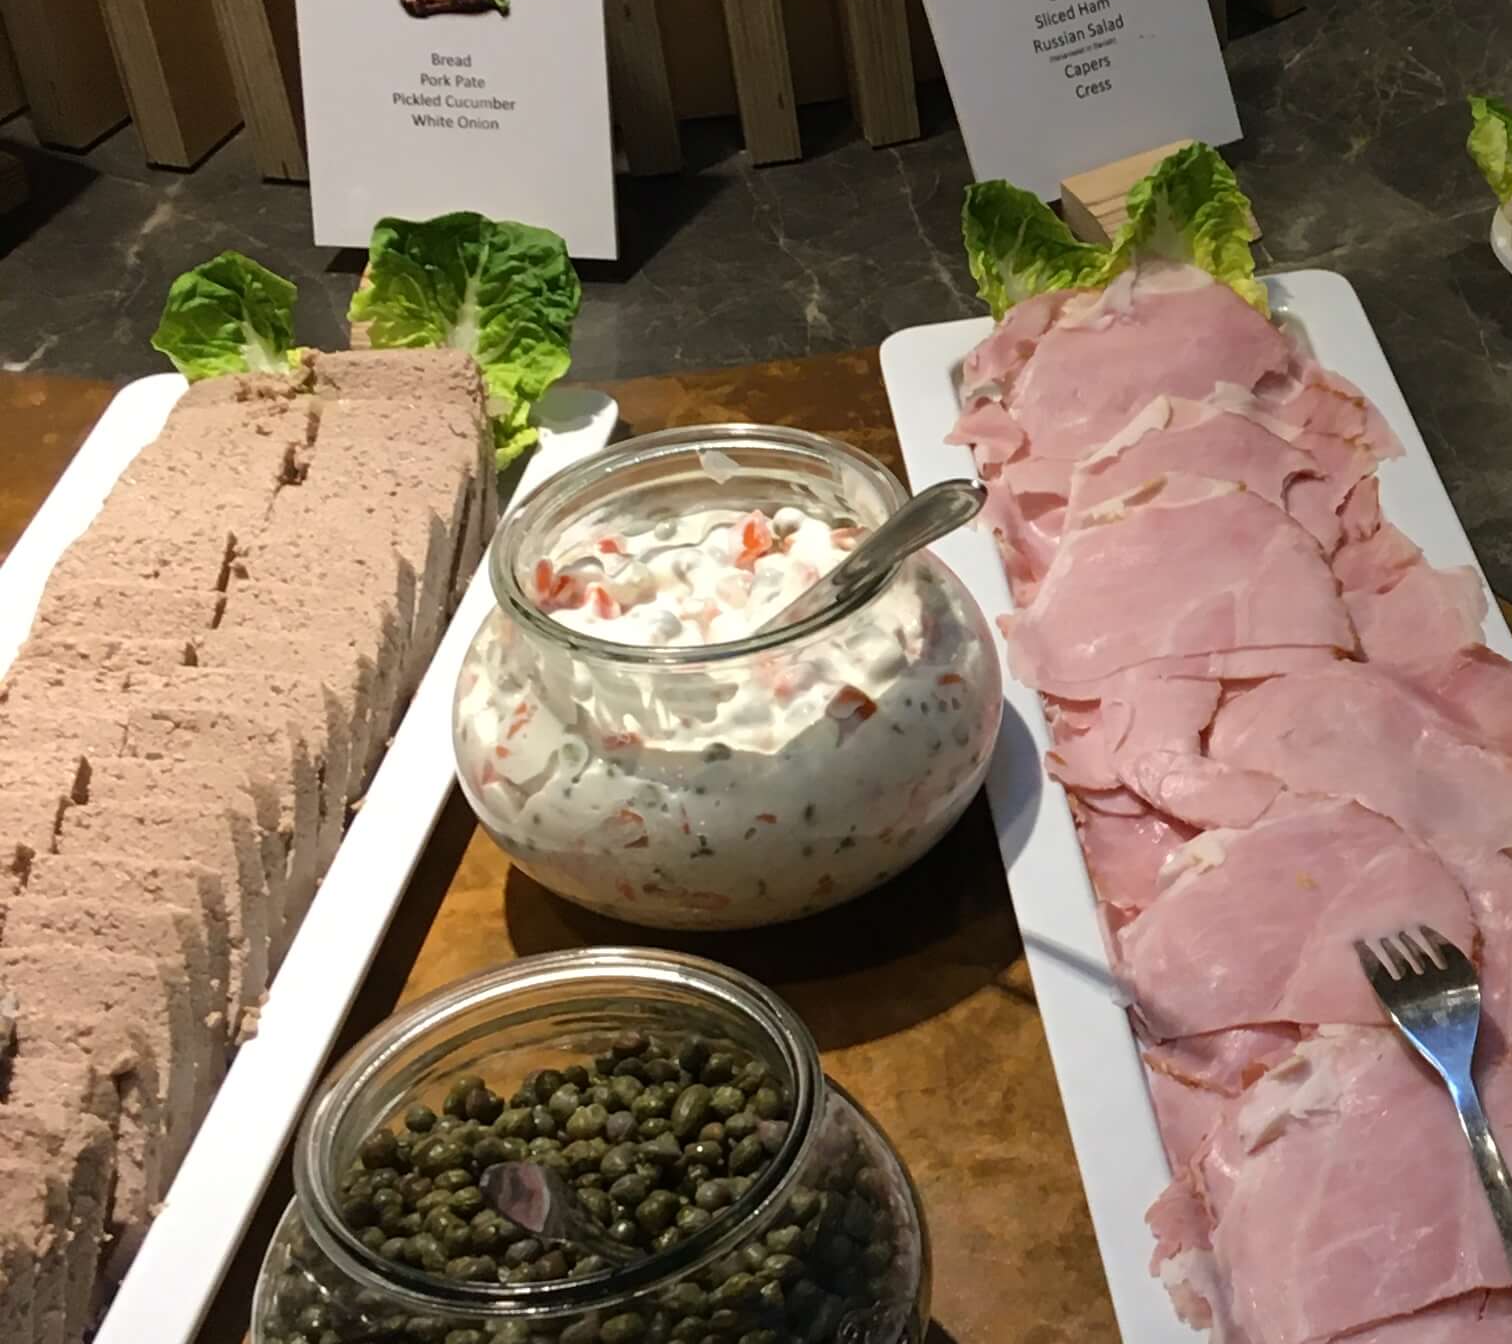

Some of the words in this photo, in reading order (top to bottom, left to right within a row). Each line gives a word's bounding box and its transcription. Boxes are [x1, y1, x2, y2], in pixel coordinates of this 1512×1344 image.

[1034, 4, 1076, 30] Sliced
[1033, 30, 1086, 54] Russian
[1087, 12, 1125, 38] Salad
[431, 52, 473, 68] Bread
[1064, 55, 1112, 79] Capers
[420, 72, 452, 88] Pork
[455, 74, 486, 89] Pate
[1075, 78, 1113, 99] Cress
[392, 91, 443, 108] Pickled
[445, 93, 517, 111] Cucumber
[411, 113, 455, 129] White
[457, 115, 501, 130] Onion
